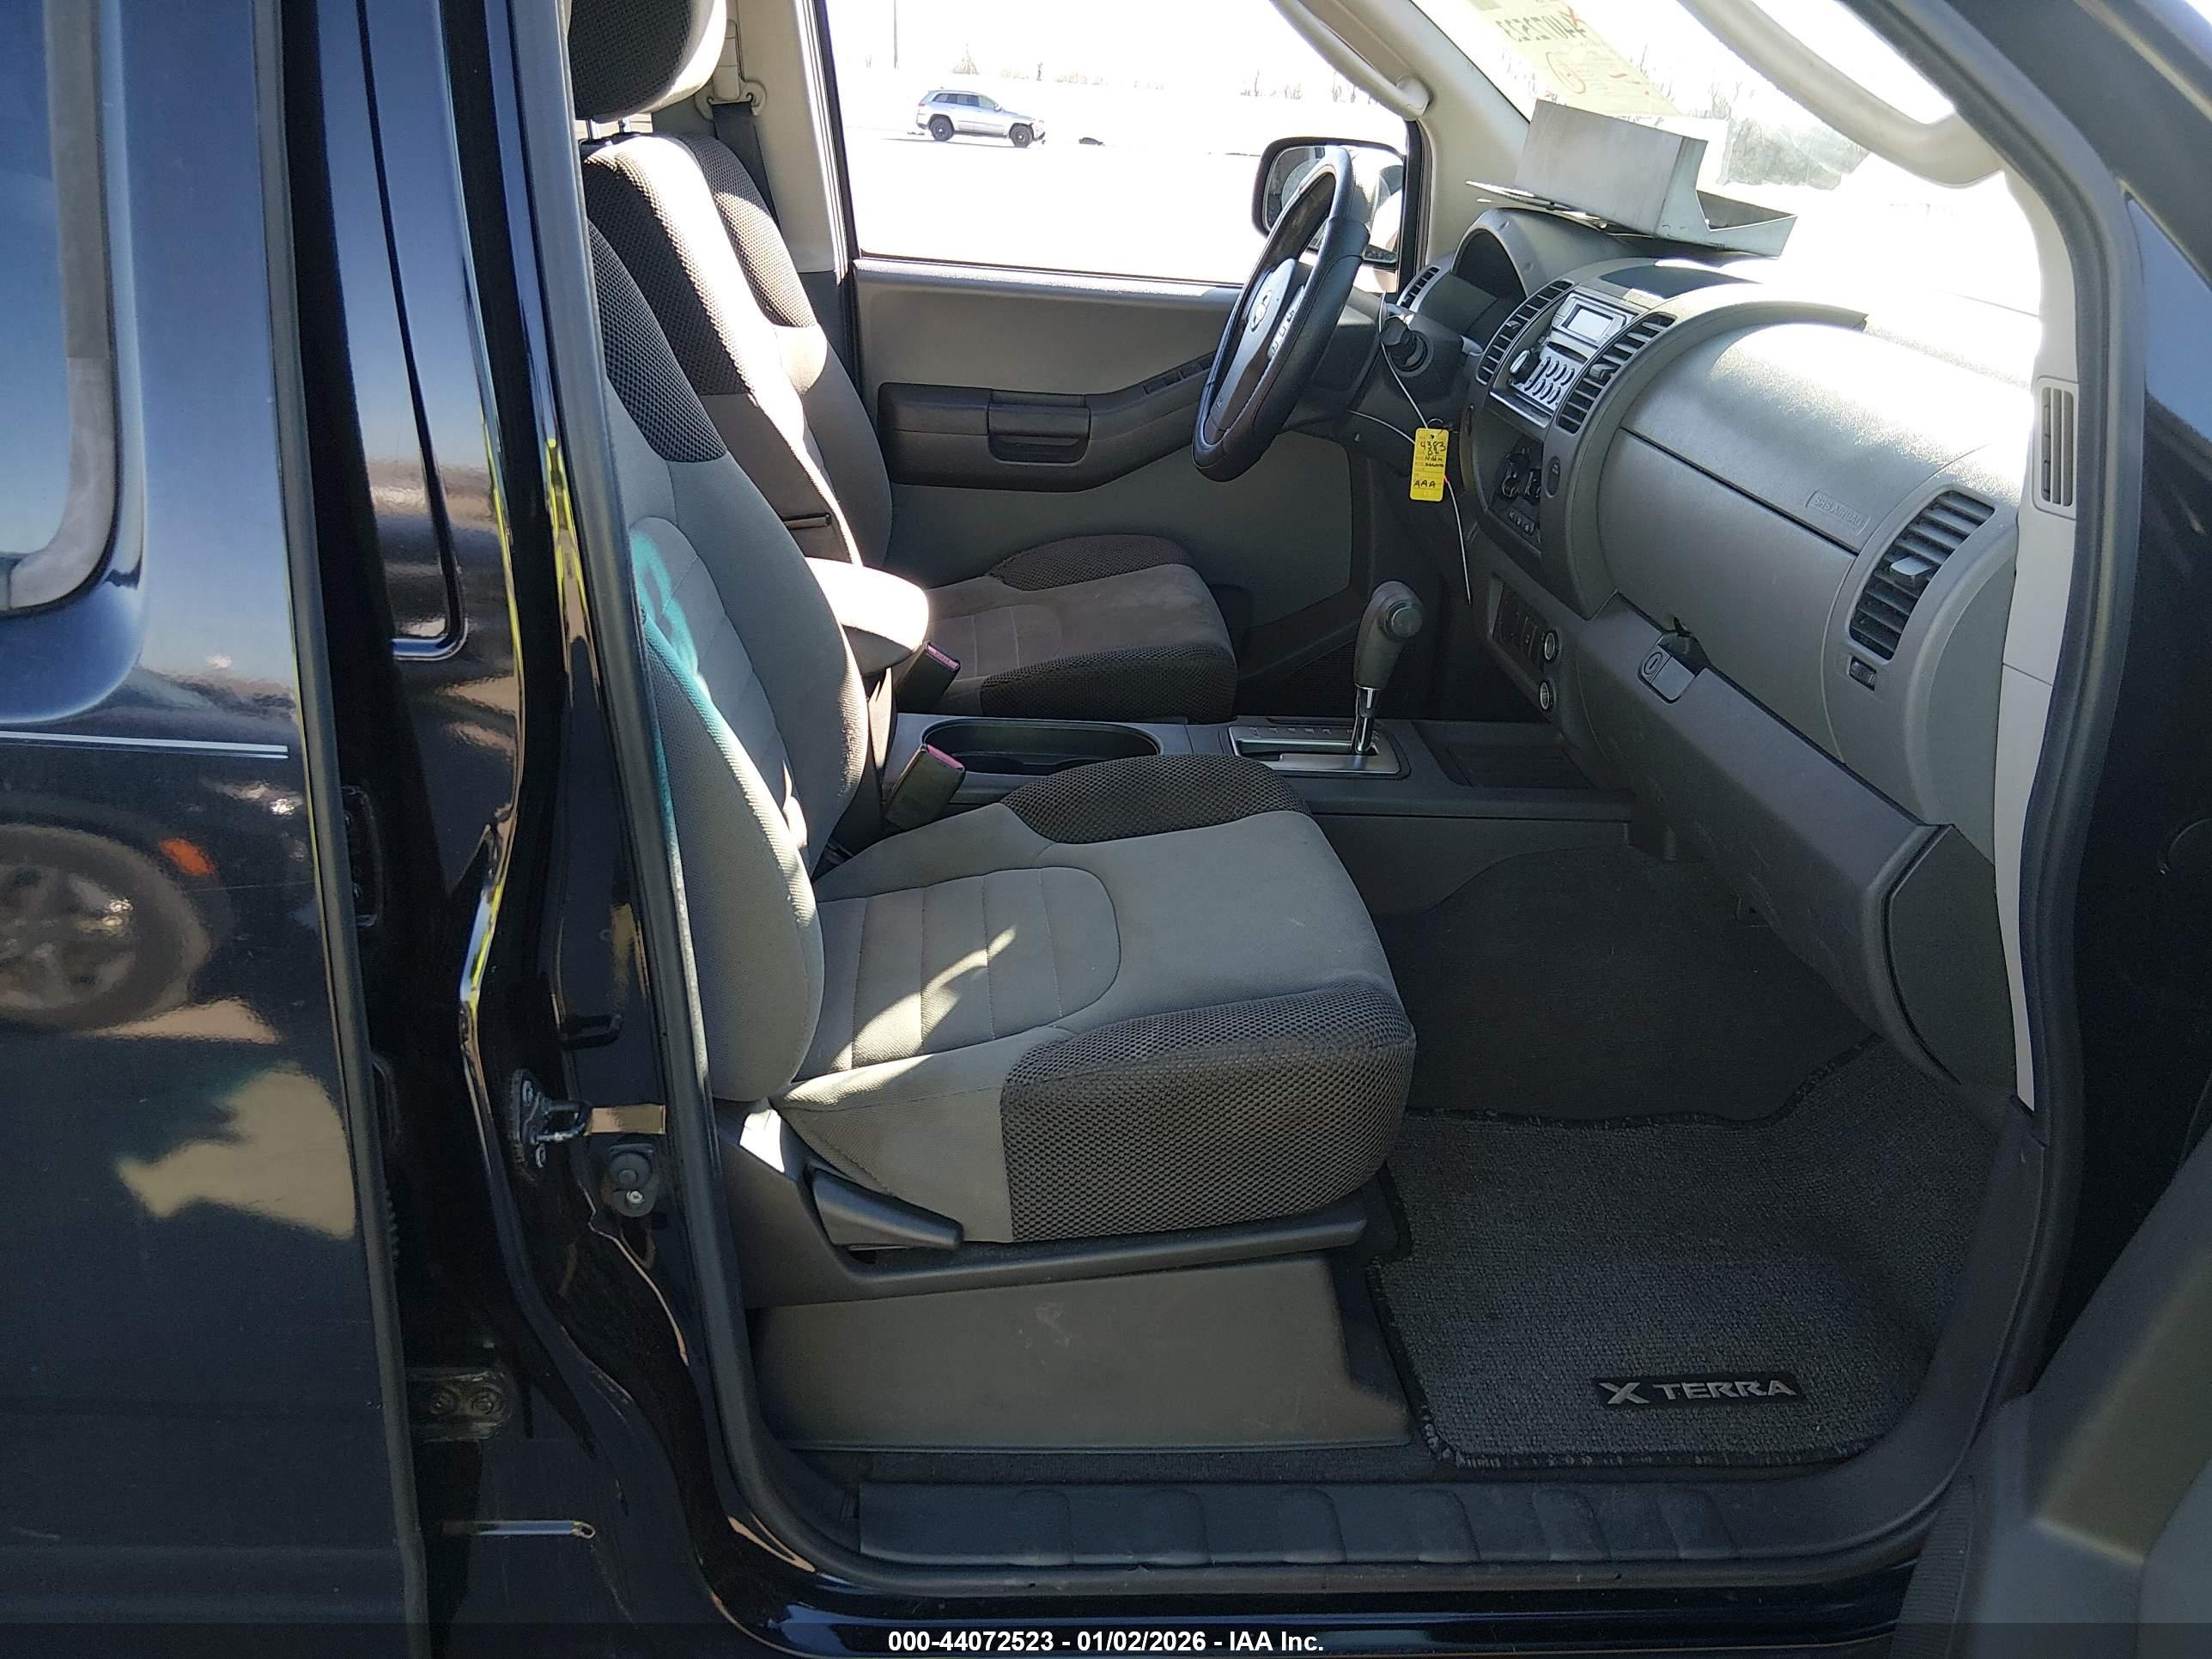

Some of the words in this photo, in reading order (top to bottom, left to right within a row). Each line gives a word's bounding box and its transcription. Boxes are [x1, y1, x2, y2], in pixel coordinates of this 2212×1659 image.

[1413, 479, 1436, 488] AAA
[1598, 1381, 1650, 1406] X
[1652, 1379, 1796, 1401] TERRA
